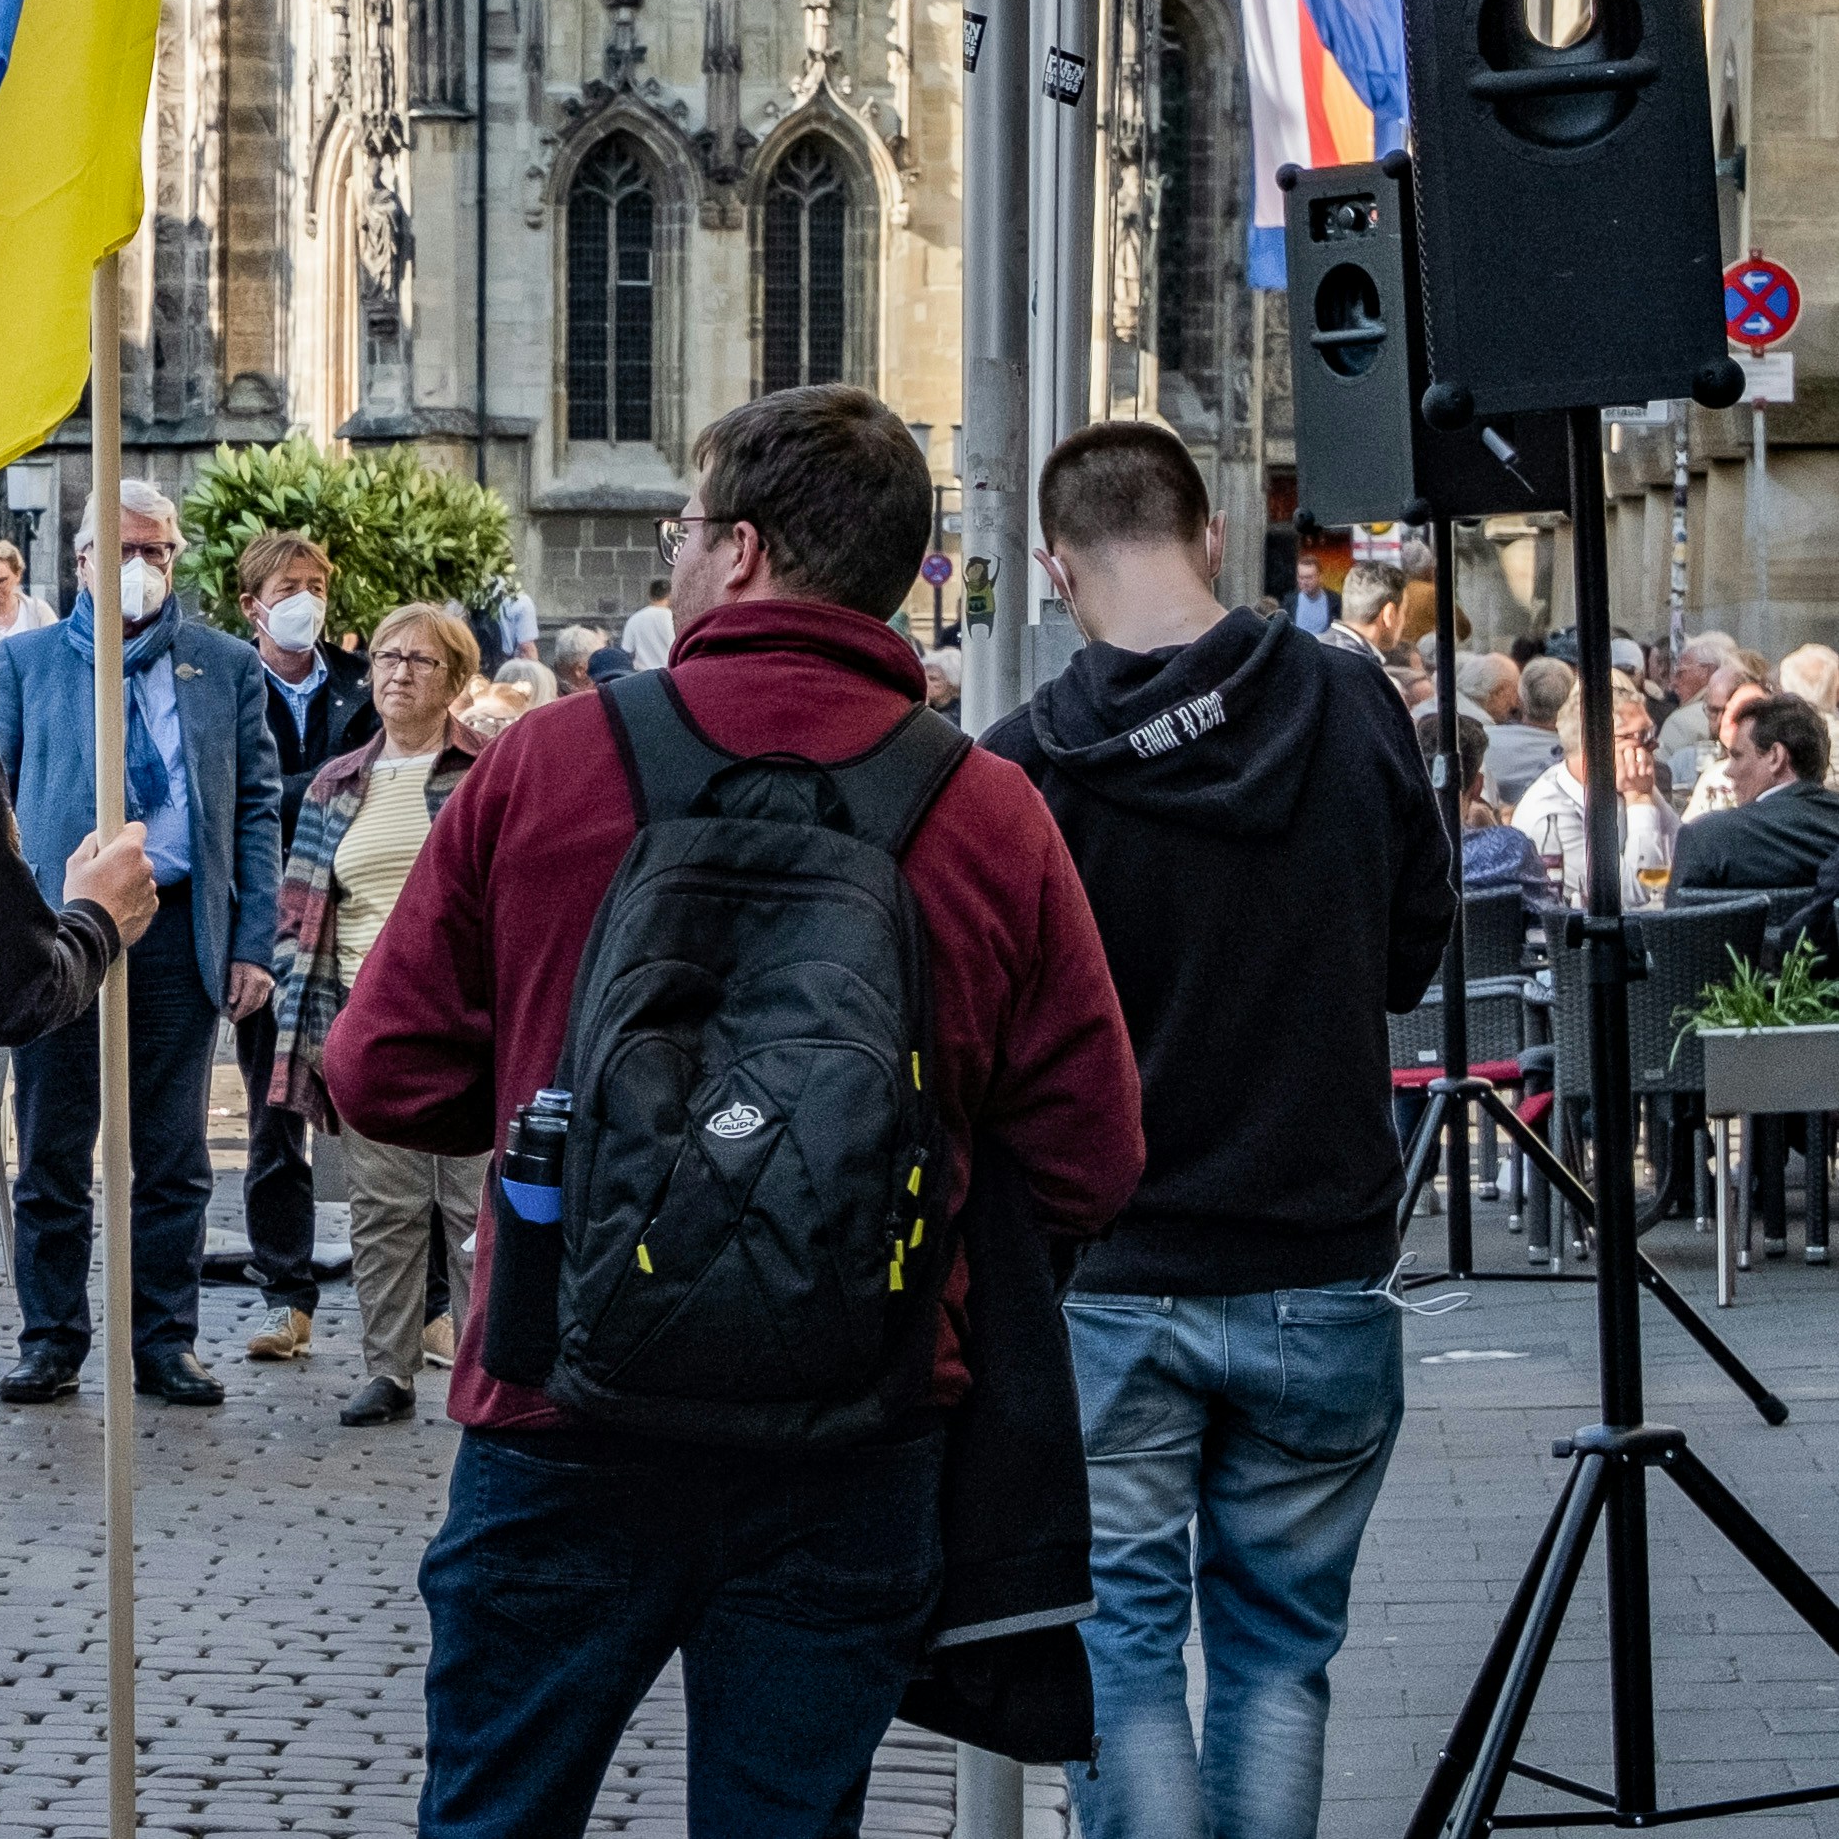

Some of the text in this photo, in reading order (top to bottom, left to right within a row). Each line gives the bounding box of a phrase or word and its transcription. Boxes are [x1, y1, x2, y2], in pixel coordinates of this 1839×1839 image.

[1128, 690, 1227, 759] JACK & JONES
